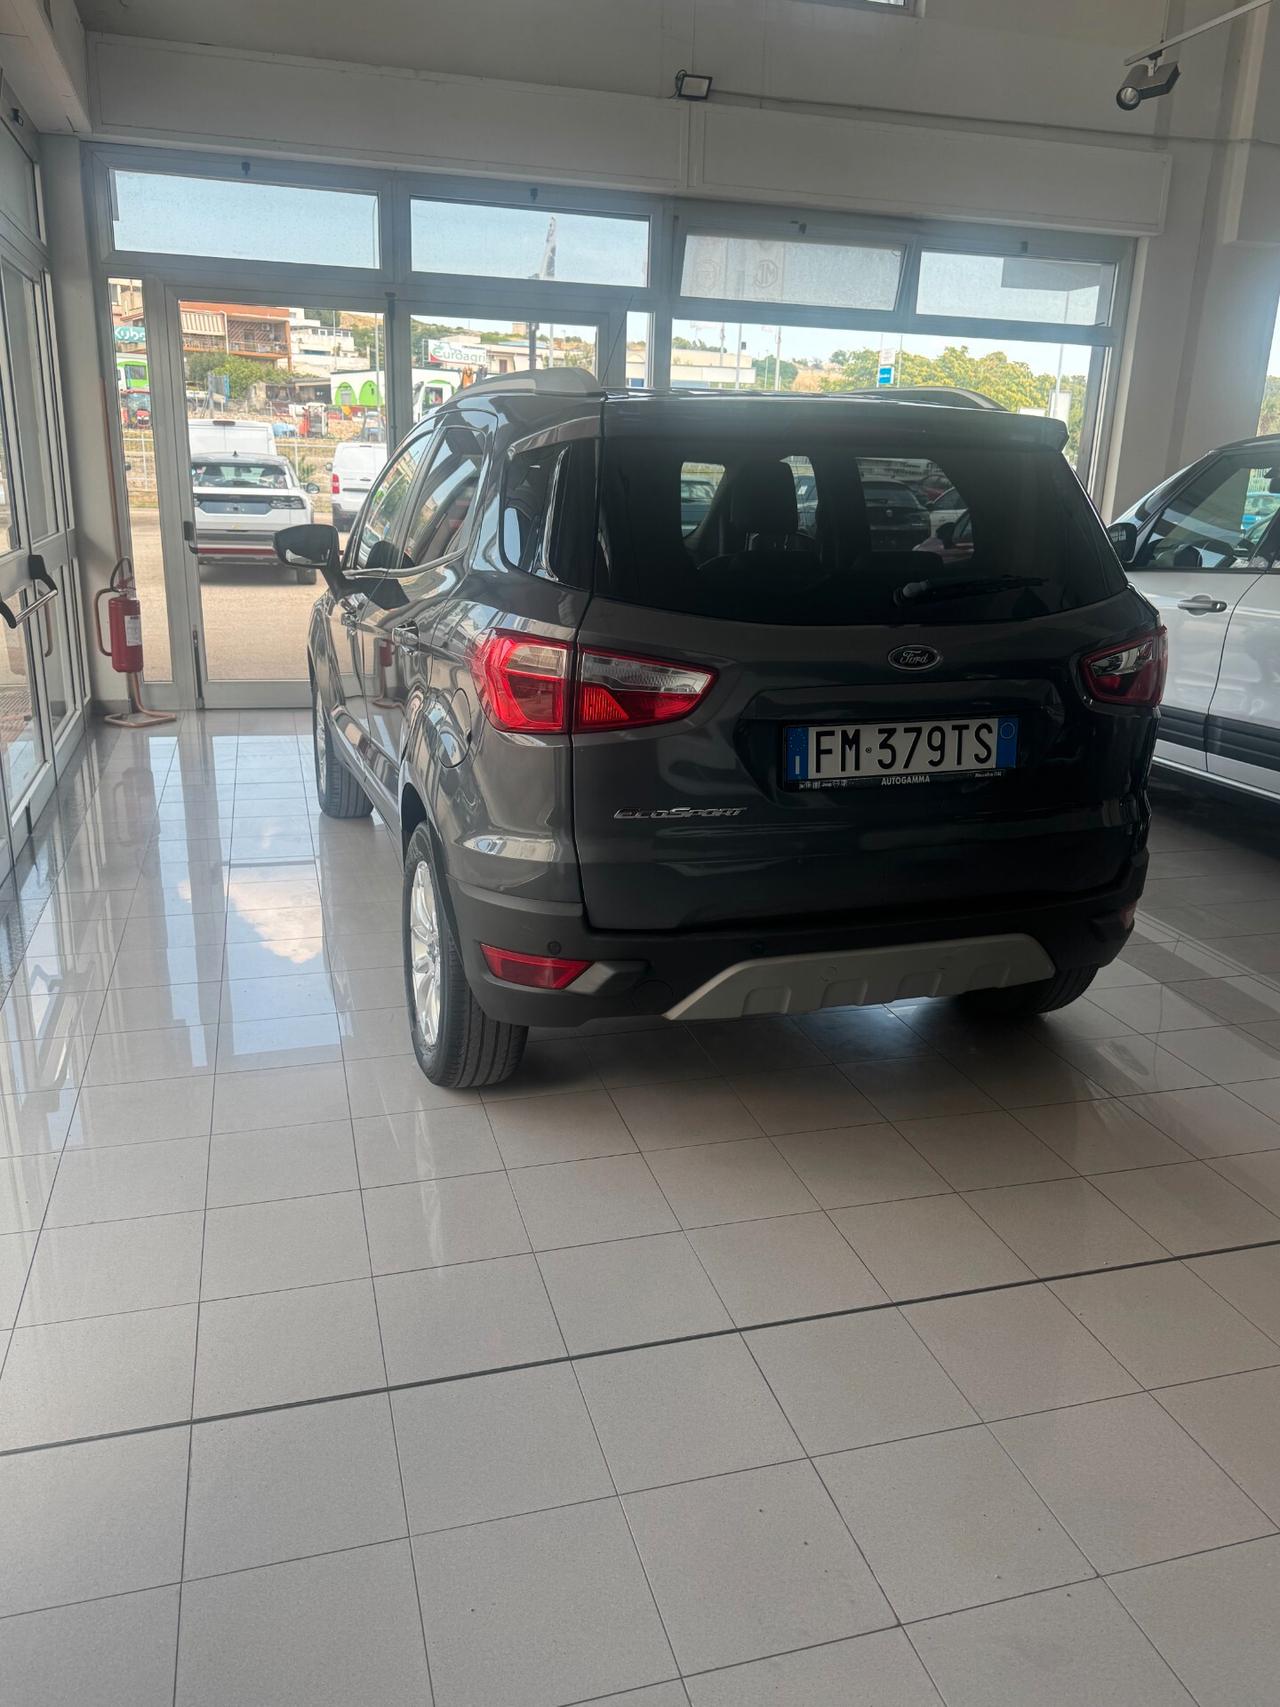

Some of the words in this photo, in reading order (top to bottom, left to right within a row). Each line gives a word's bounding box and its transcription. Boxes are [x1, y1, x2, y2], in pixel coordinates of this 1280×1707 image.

[899, 650, 929, 664] Ford
[815, 729, 861, 774] FM
[877, 722, 993, 770] 379TS
[881, 775, 930, 786] AUTOGAMMA
